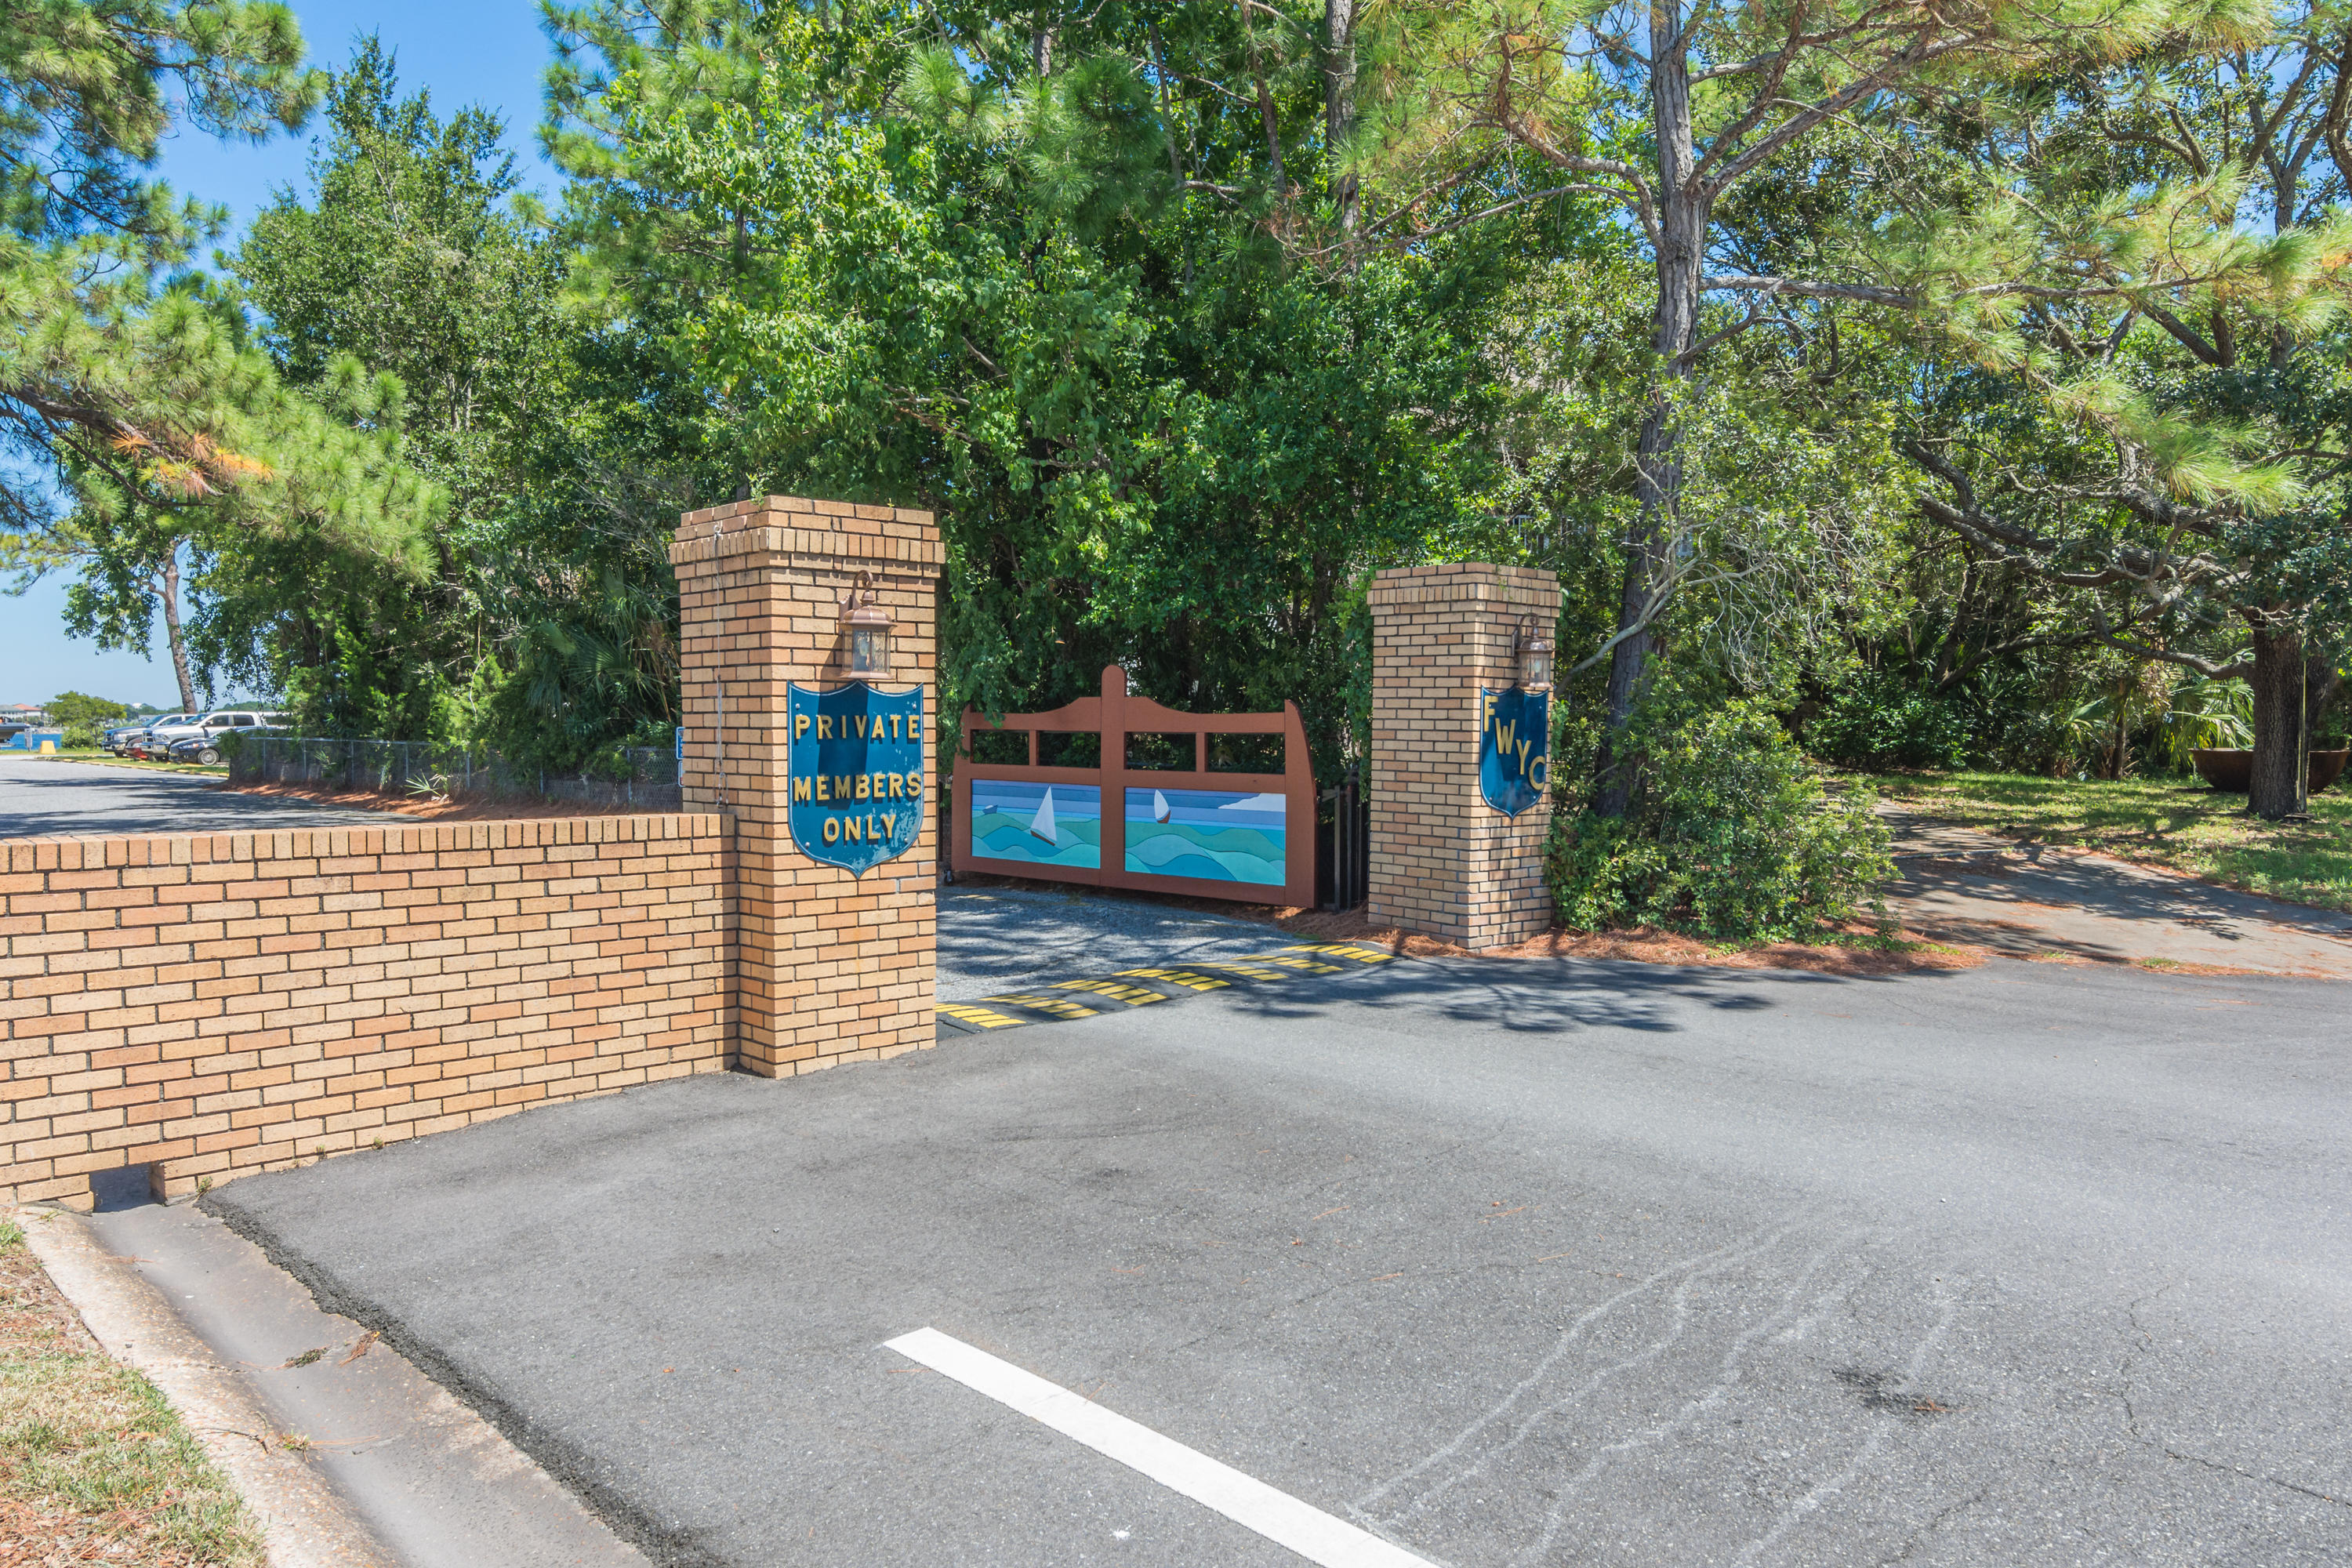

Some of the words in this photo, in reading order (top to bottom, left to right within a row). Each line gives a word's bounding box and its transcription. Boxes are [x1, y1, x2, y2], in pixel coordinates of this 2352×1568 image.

[794, 715, 920, 739] PRIVATE
[1483, 695, 1545, 790] FWYC
[794, 773, 921, 801] MEMBERS
[823, 814, 896, 842] ONLY
